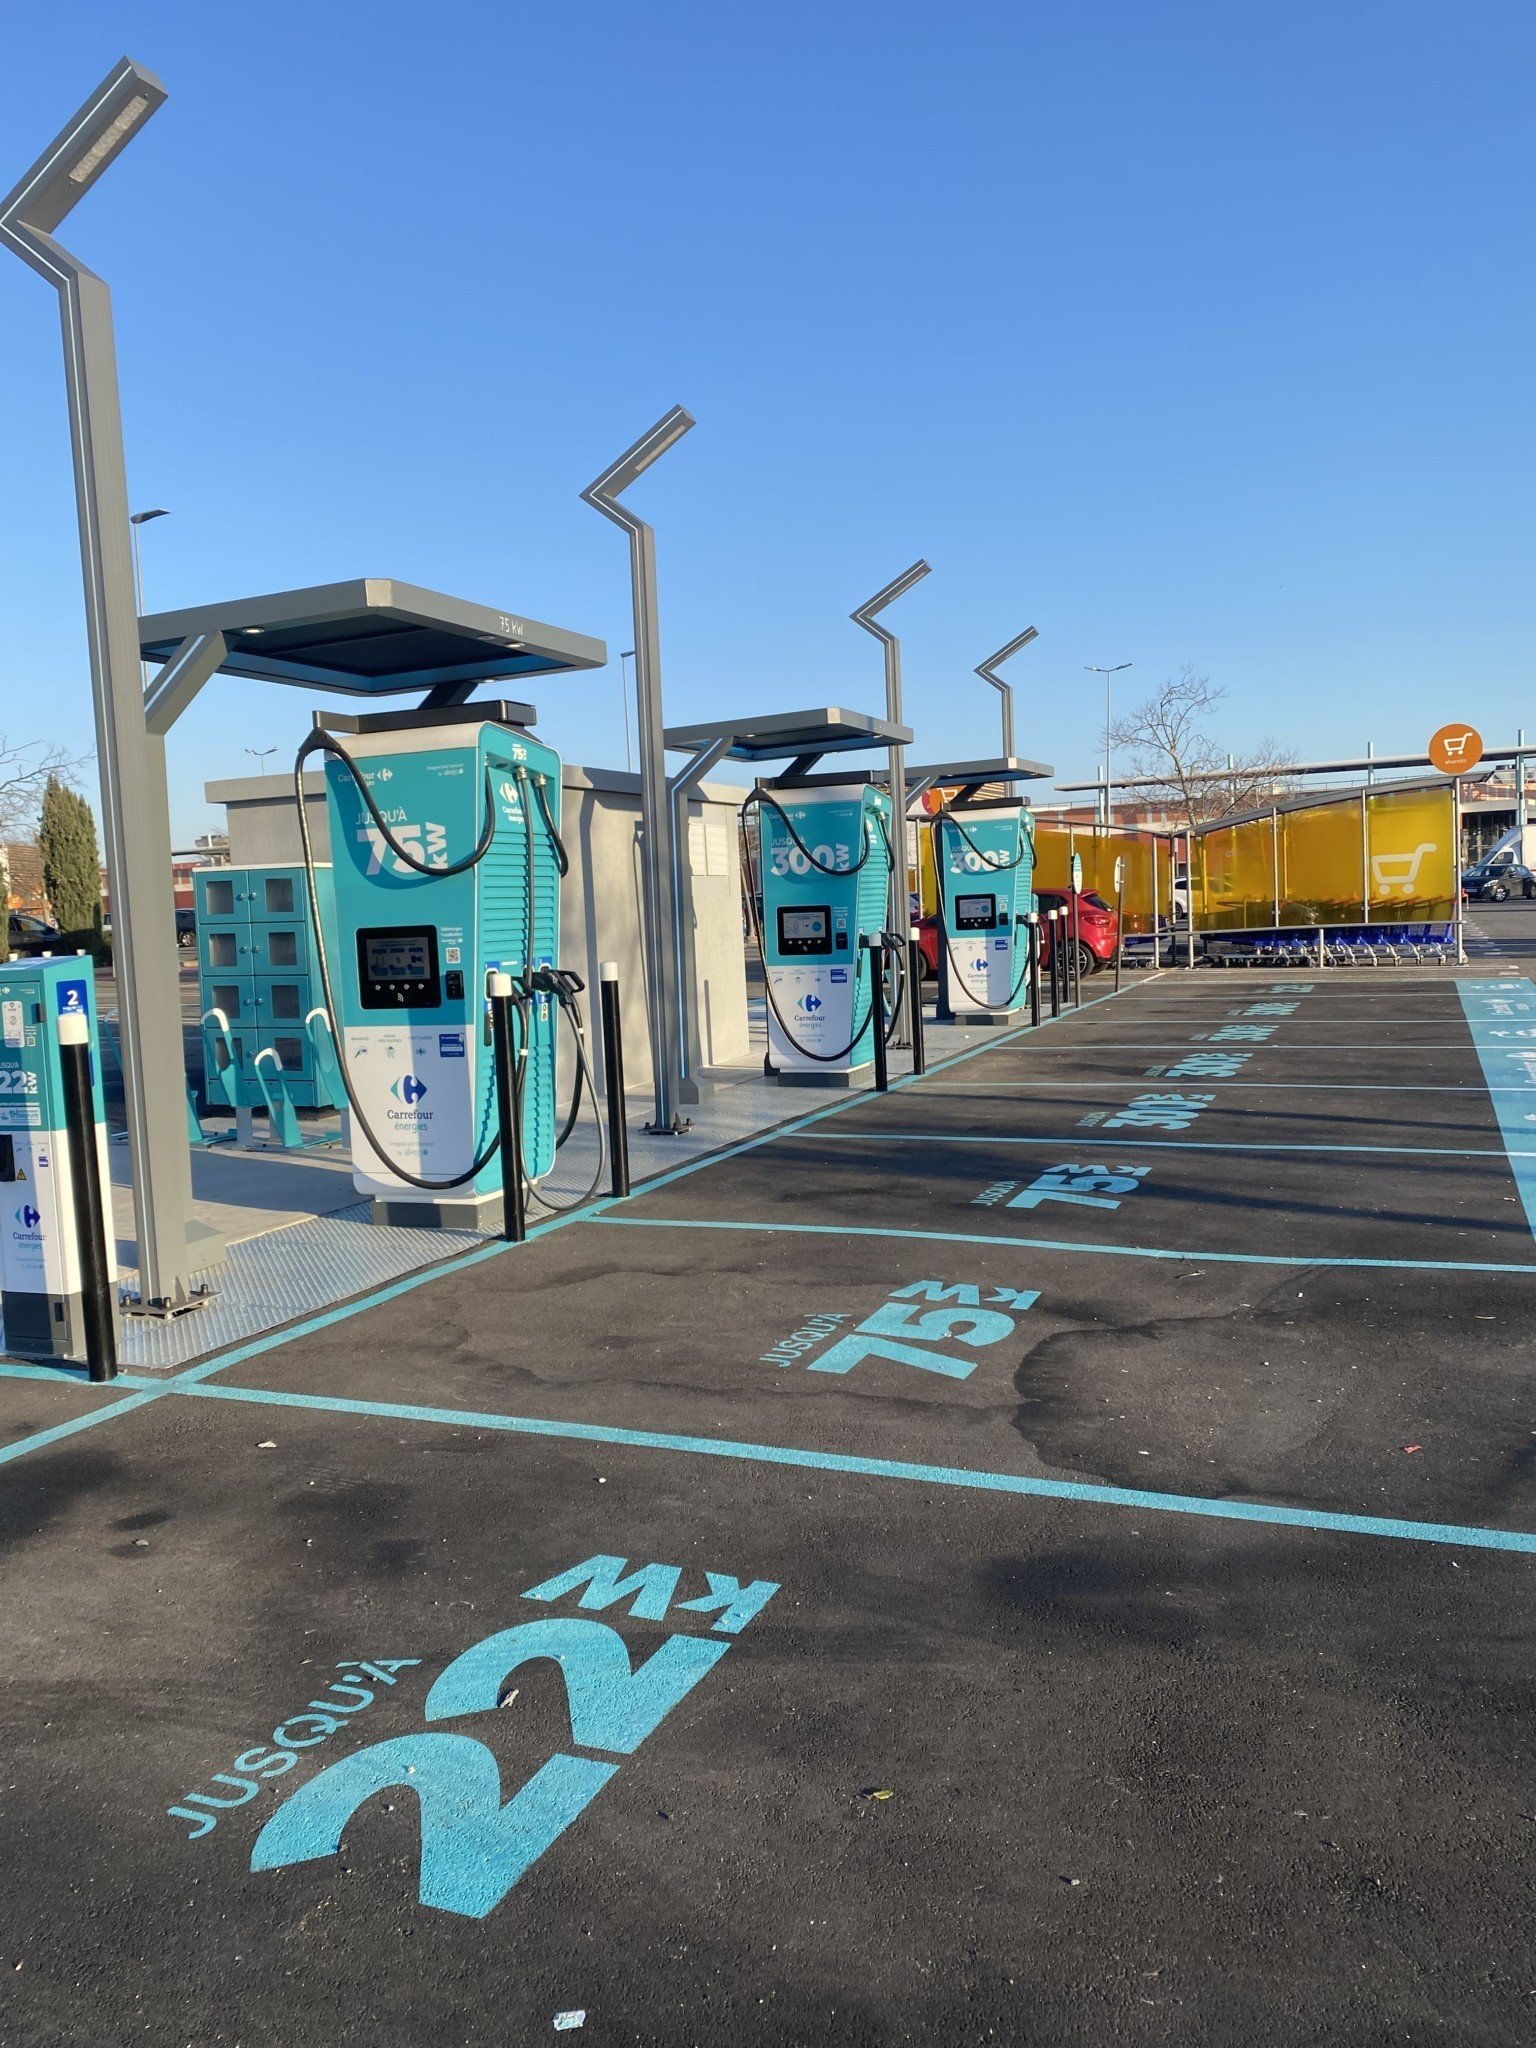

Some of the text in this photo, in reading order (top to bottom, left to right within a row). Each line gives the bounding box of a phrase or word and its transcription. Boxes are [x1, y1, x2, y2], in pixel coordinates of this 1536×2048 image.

[499, 616, 510, 633] 75
[357, 824, 425, 876] 75
[770, 844, 835, 876] 300
[950, 850, 999, 874] 300
[66, 989, 79, 1006] 2
[794, 1014, 826, 1022] Carrefour
[1164, 1056, 1249, 1078] 300
[0, 1070, 29, 1094] 22
[387, 1109, 434, 1120] Carrefour
[1101, 1100, 1209, 1131] 300
[394, 1120, 428, 1134] énergies
[1005, 1174, 1139, 1210] 75
[12, 1231, 47, 1241] Carrefour
[759, 1311, 852, 1368] JUSQU'À
[806, 1302, 1016, 1380] 75
[167, 1657, 423, 1840] JUSQU'À
[250, 1617, 733, 1920] 22
